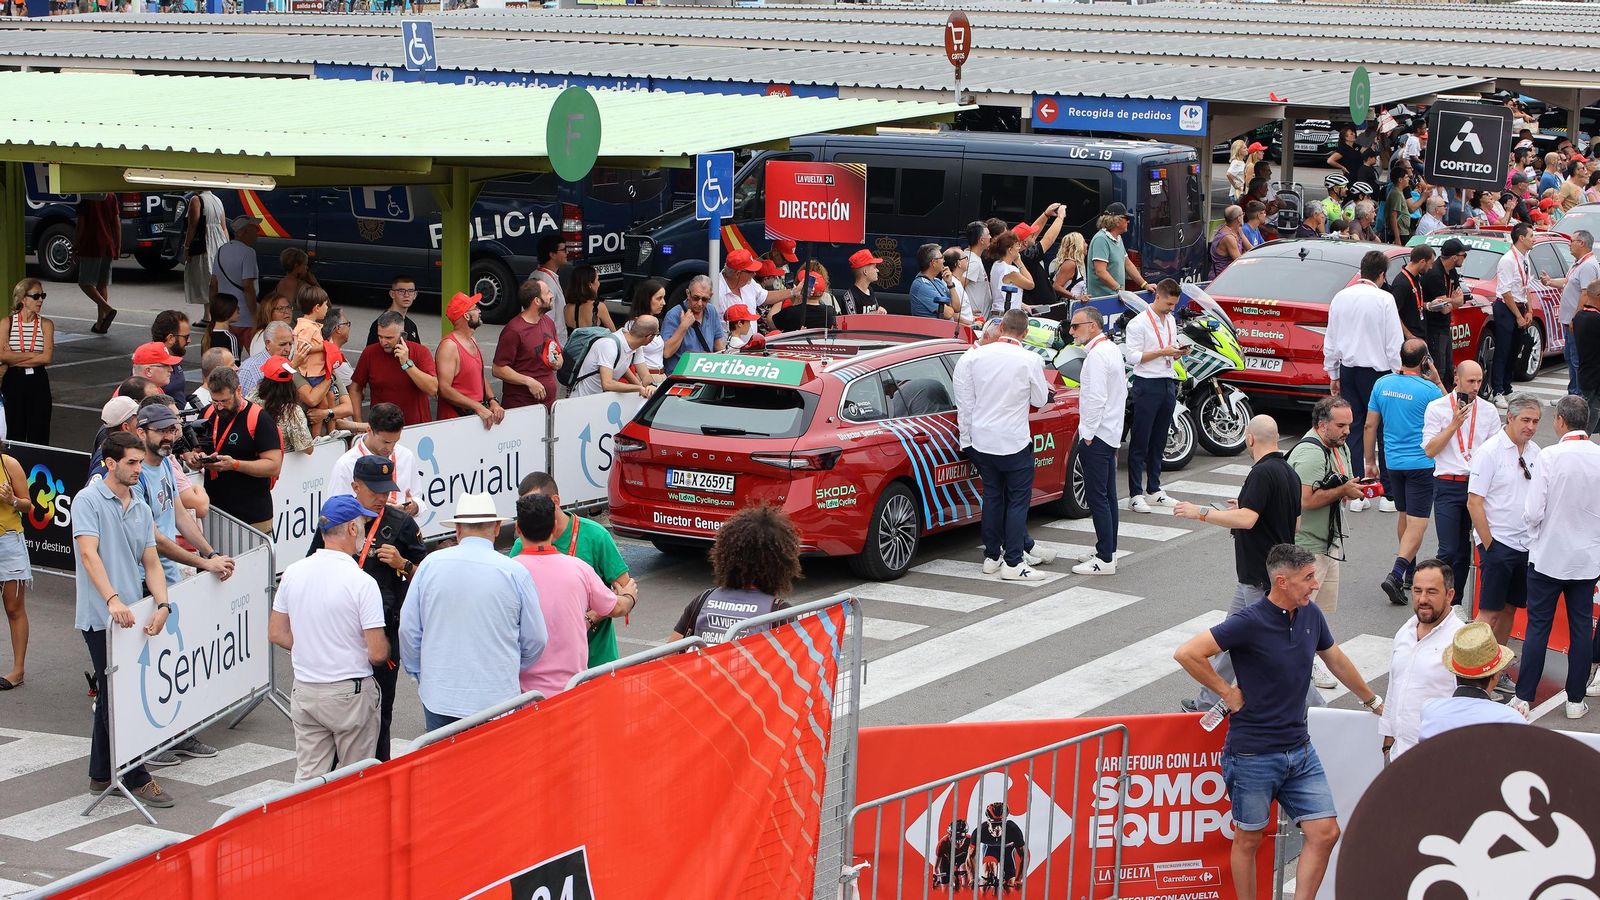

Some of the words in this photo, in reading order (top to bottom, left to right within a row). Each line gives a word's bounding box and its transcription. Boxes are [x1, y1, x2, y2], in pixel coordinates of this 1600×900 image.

[1356, 82, 1364, 110] G
[1068, 107, 1114, 119] Recogida
[1117, 108, 1128, 119] de
[1132, 108, 1172, 120] pedidos
[566, 113, 585, 157] F
[1069, 148, 1089, 160] UC
[1099, 150, 1113, 160] 19
[1440, 160, 1492, 174] CORTIZO
[825, 176, 832, 184] 24
[779, 198, 850, 221] DIRECCIÓN
[1258, 308, 1280, 316] Cycling
[1240, 320, 1285, 328] KODA
[1251, 329, 1284, 340] Electric
[1450, 323, 1470, 340] ODA
[1241, 346, 1276, 354] rganización
[692, 358, 780, 380] Fertiberia
[1260, 359, 1280, 370] MCP
[1382, 390, 1412, 400] SHIMANO
[498, 438, 522, 453] grupo
[662, 450, 732, 462] SKODA
[1034, 456, 1054, 467] Partner
[946, 464, 967, 480] VUELTA
[970, 463, 978, 476] 24
[303, 478, 324, 492] grupo
[673, 472, 685, 486] DA
[816, 484, 856, 500] SKODA
[696, 496, 734, 506] Cycling.com
[816, 501, 826, 509] We
[839, 498, 857, 506] Cycling
[653, 512, 692, 528] Director
[694, 516, 724, 530] Gener
[24, 540, 34, 548] en
[36, 541, 40, 552] y
[42, 540, 71, 554] destino
[230, 593, 250, 615] grupo
[706, 600, 758, 612] SHIMANO
[158, 610, 250, 704] Serviall
[1166, 753, 1190, 769] CON
[1193, 752, 1208, 768] LA
[1091, 771, 1232, 810] SOMO
[1099, 869, 1111, 881] LA
[1162, 874, 1196, 883] Carrefour
